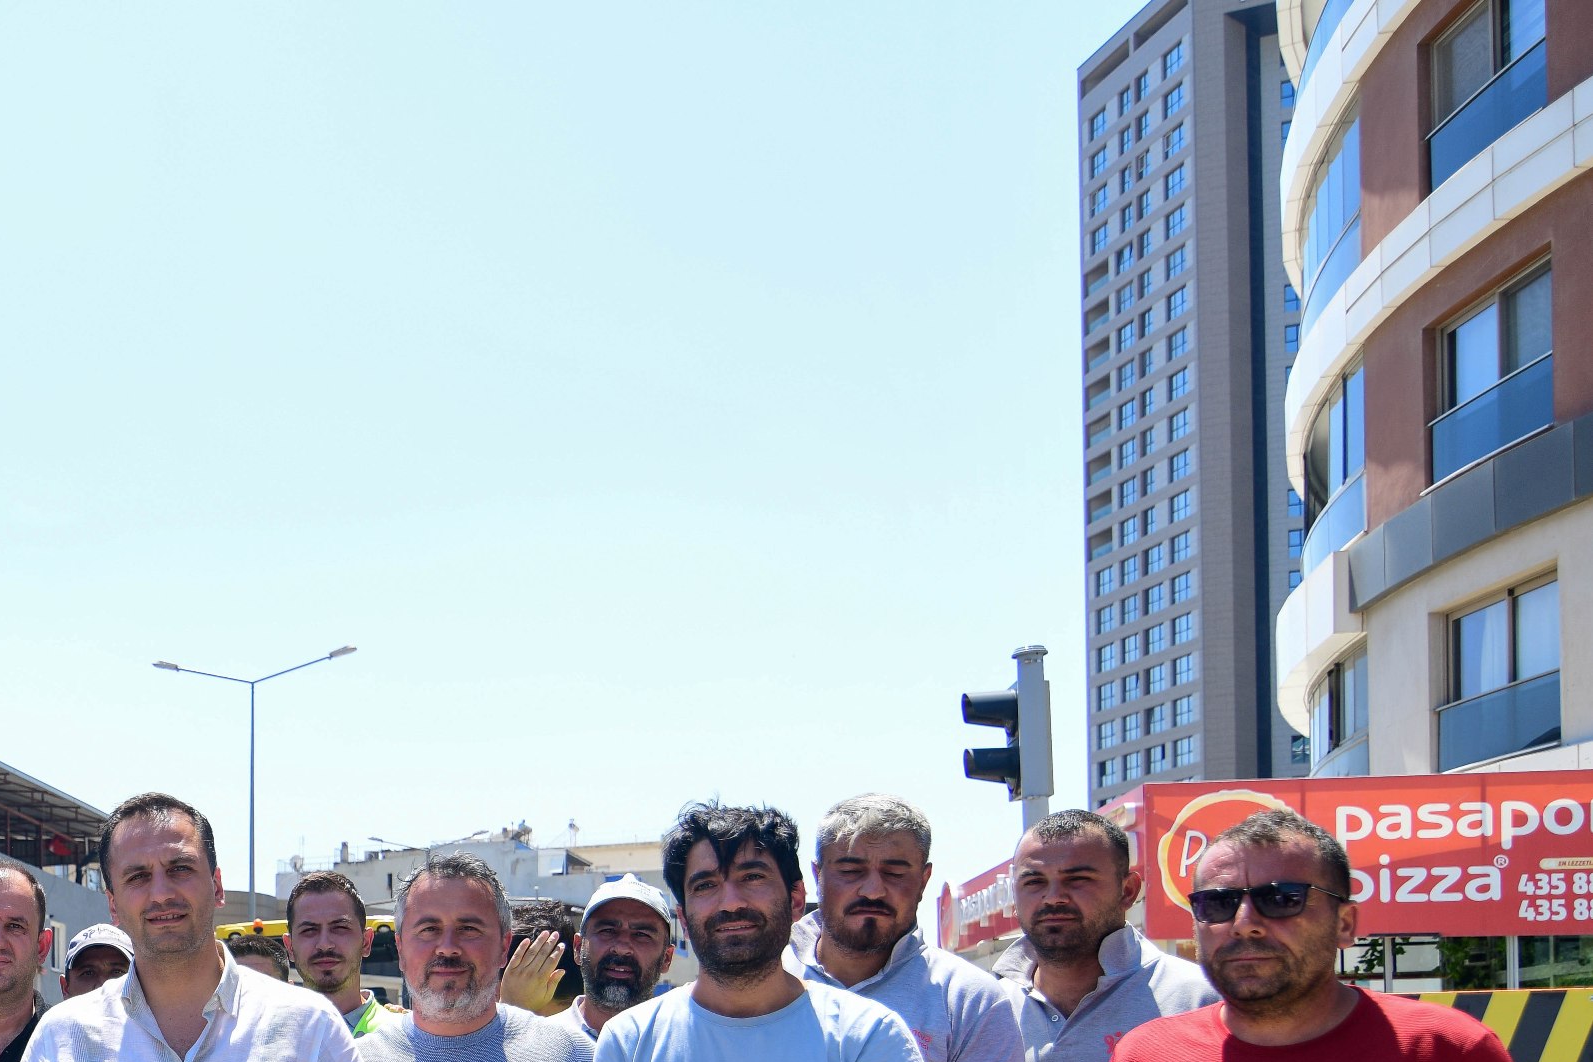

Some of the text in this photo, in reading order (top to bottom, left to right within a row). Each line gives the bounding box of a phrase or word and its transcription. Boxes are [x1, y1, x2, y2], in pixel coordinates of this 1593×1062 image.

[1335, 798, 1593, 851] pasapo
[1518, 872, 1593, 896] 435 8
[1518, 897, 1593, 922] 435 8
